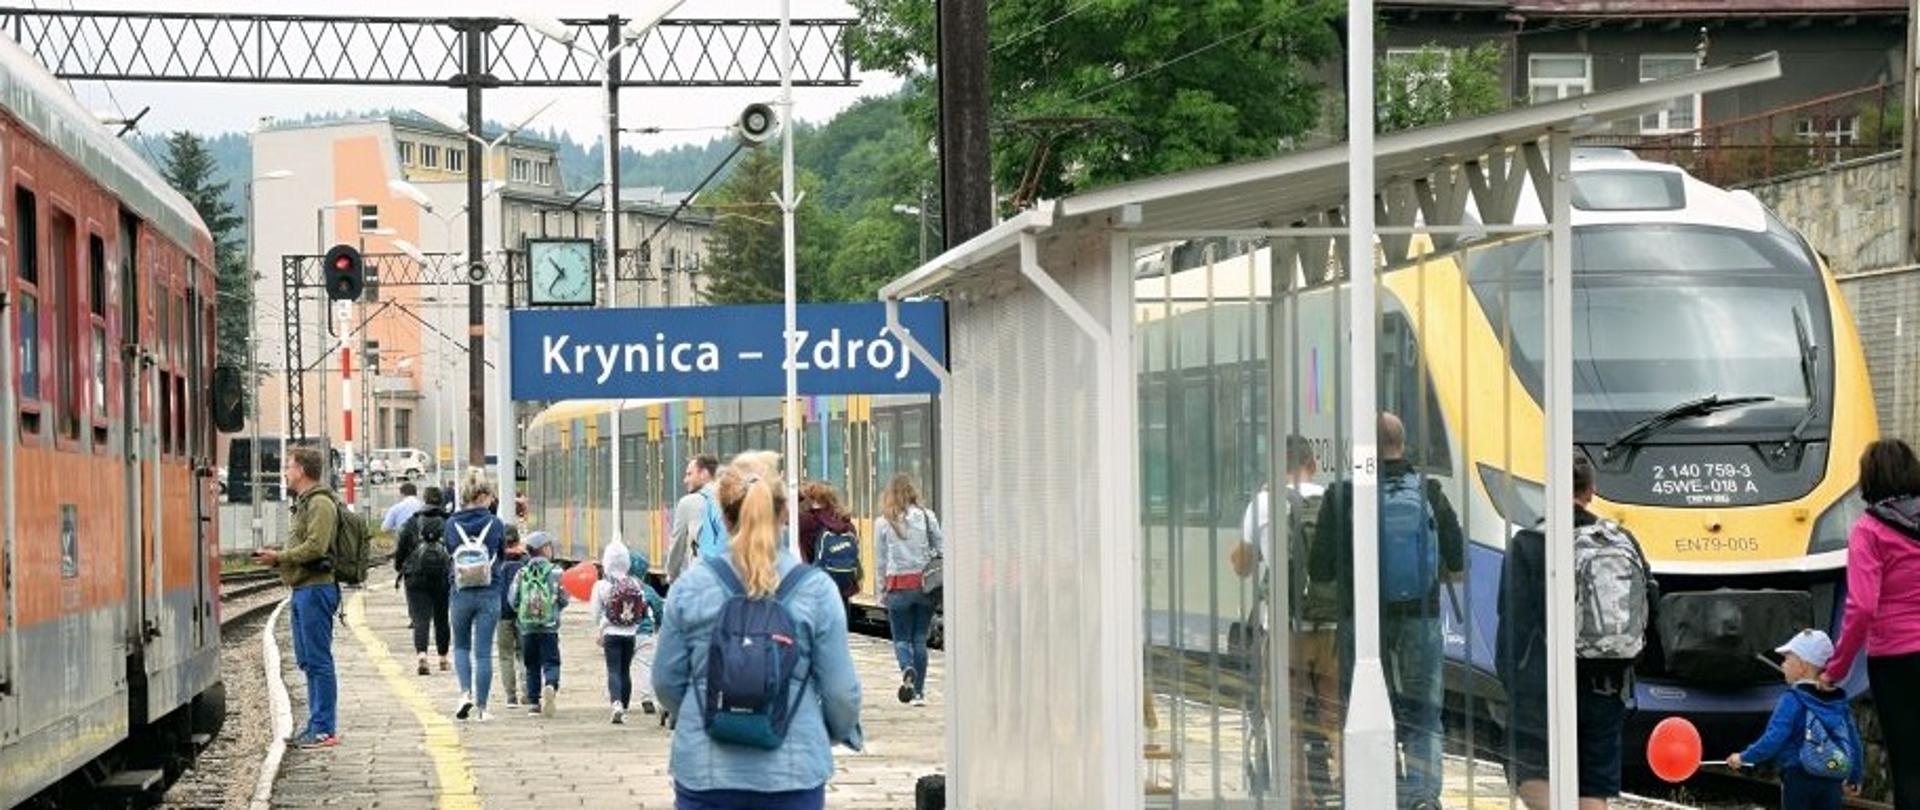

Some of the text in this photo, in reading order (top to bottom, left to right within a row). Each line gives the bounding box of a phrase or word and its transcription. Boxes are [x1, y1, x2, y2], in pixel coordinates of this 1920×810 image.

[543, 332, 719, 385] Krynica
[782, 326, 910, 379] Zdrój
[1653, 465, 1664, 479] 2
[1669, 464, 1700, 478] 140
[1652, 479, 1759, 494] 45WE-018 A
[1675, 538, 1759, 552] EN79-005
